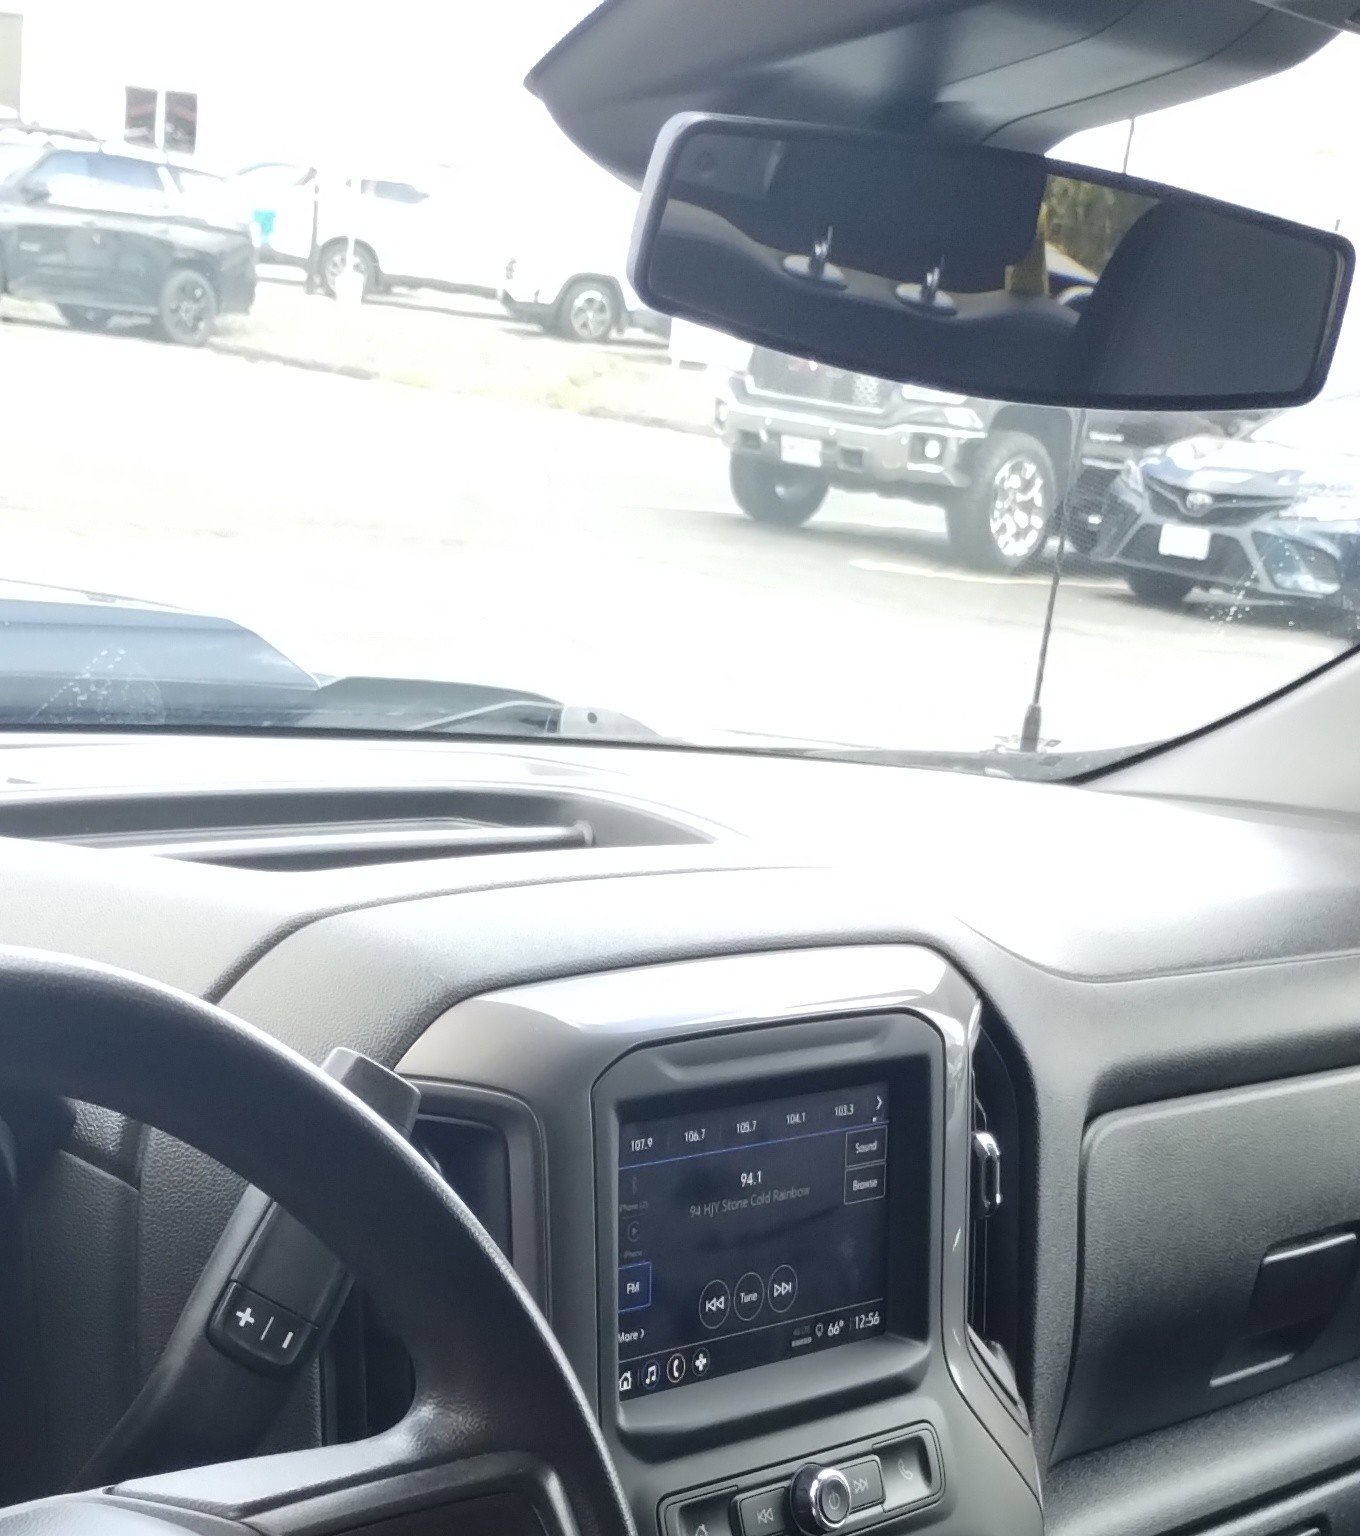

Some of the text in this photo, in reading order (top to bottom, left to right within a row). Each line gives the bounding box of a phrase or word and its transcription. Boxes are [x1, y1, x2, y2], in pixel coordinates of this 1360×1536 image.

[631, 1137, 653, 1152] 107.9
[740, 1170, 762, 1188] 94.1
[772, 1186, 811, 1203] Rainbow
[626, 1281, 640, 1295] FM
[740, 1291, 758, 1303] Tune
[855, 1311, 880, 1329] 12:56
[618, 1331, 638, 1344] More
